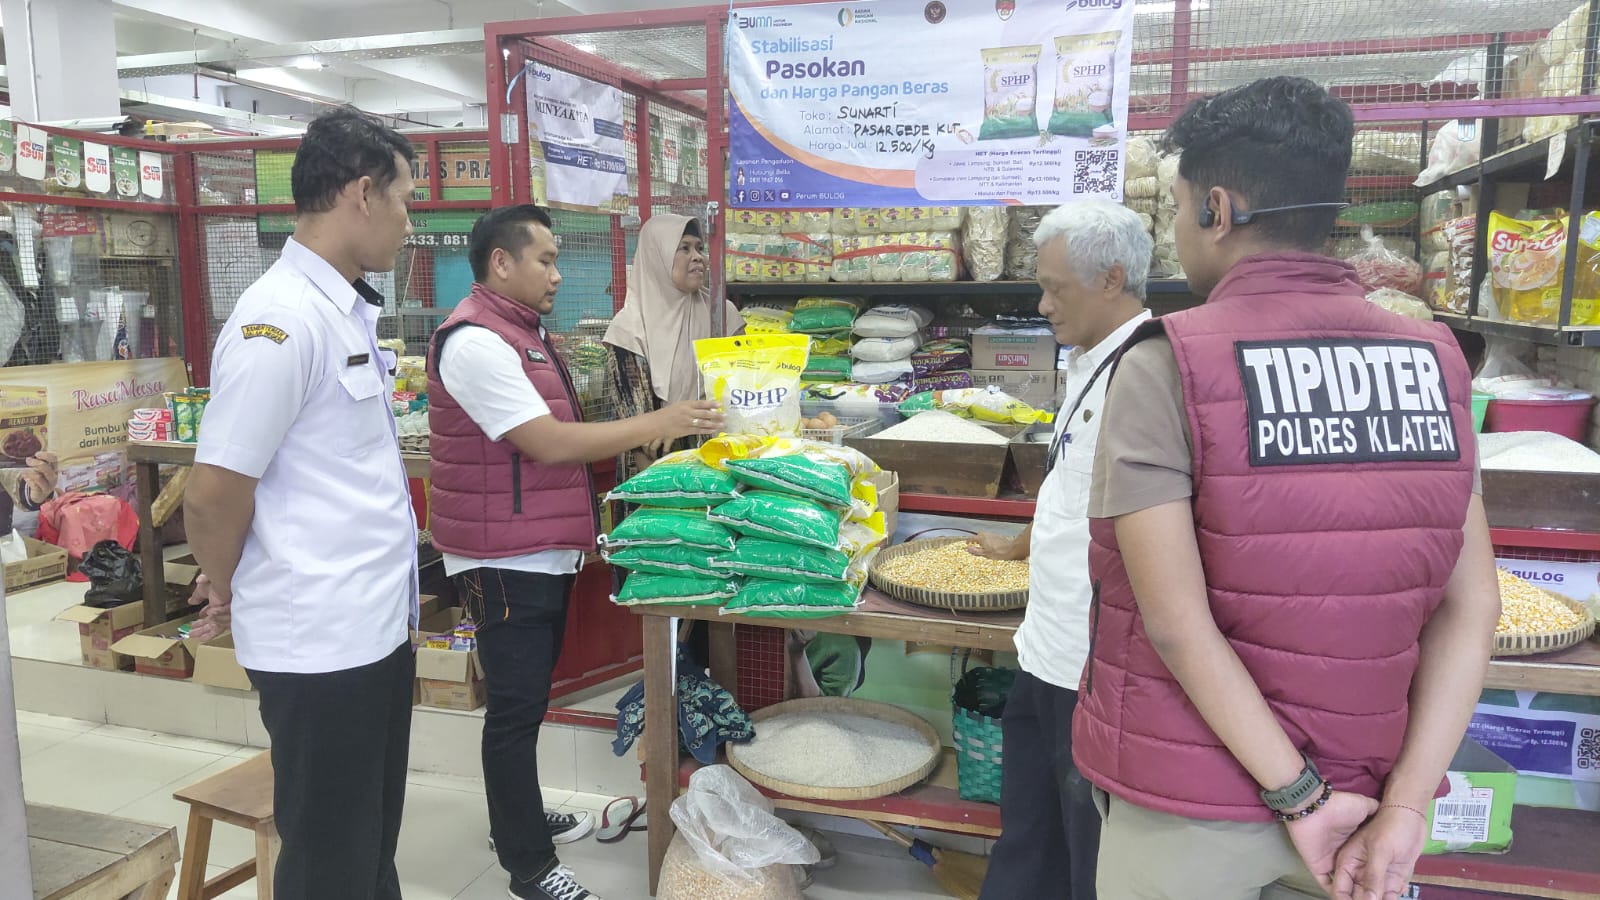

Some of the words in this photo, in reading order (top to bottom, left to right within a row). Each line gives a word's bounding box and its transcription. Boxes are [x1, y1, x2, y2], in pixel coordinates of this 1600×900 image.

[739, 16, 773, 29] BUMN
[751, 35, 835, 55] Stabilisasi
[766, 57, 866, 81] Pasokan
[1073, 63, 1106, 76] SPHP
[1001, 74, 1030, 86] SPHP
[761, 87, 788, 99] dan
[792, 85, 838, 101] Harga
[841, 82, 899, 100] Pangan
[903, 80, 950, 96] Beras
[800, 108, 826, 121] Toko
[803, 123, 844, 136] Alamat
[853, 123, 894, 138] PASAR
[895, 124, 931, 137] GEDE
[809, 140, 842, 152] Harga
[845, 139, 867, 150] Jual
[795, 191, 818, 201] Perum
[819, 191, 846, 201] BULOG
[781, 363, 801, 373] bulog
[1243, 345, 1449, 415] TIPIDTER
[730, 386, 788, 407] SPHP
[84, 424, 121, 440] Bumbu
[1257, 417, 1358, 457] POLRES
[1365, 415, 1456, 453] KLATEN
[78, 437, 99, 452] dari
[1511, 570, 1565, 582] BULOG
